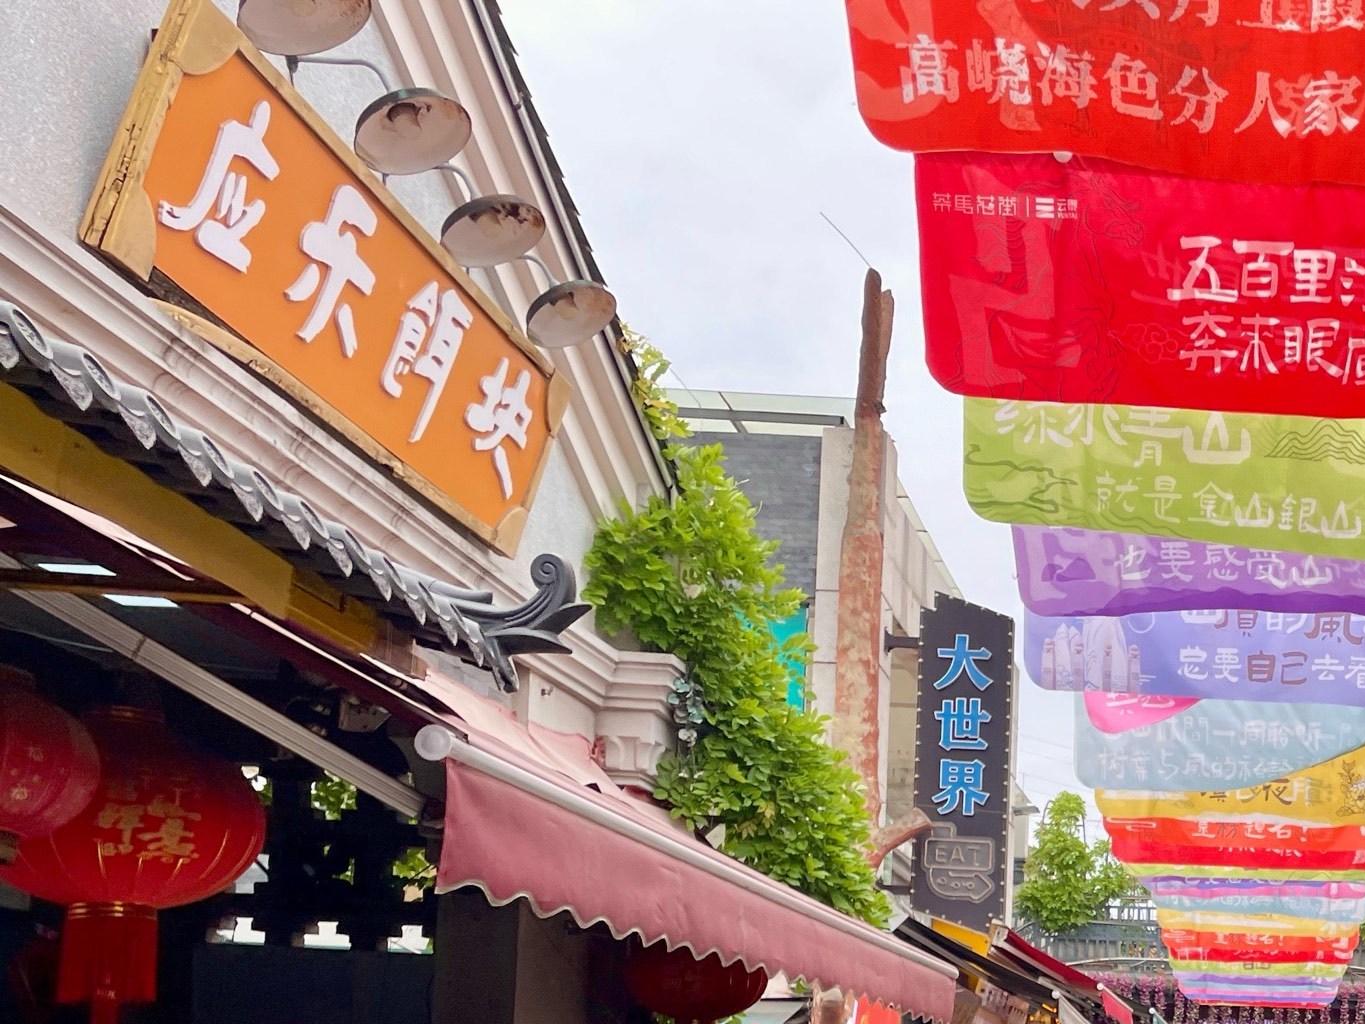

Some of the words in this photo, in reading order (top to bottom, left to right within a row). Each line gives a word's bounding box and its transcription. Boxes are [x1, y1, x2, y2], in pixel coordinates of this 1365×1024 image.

[932, 634, 994, 817] 大世界
[934, 845, 982, 867] EAT
